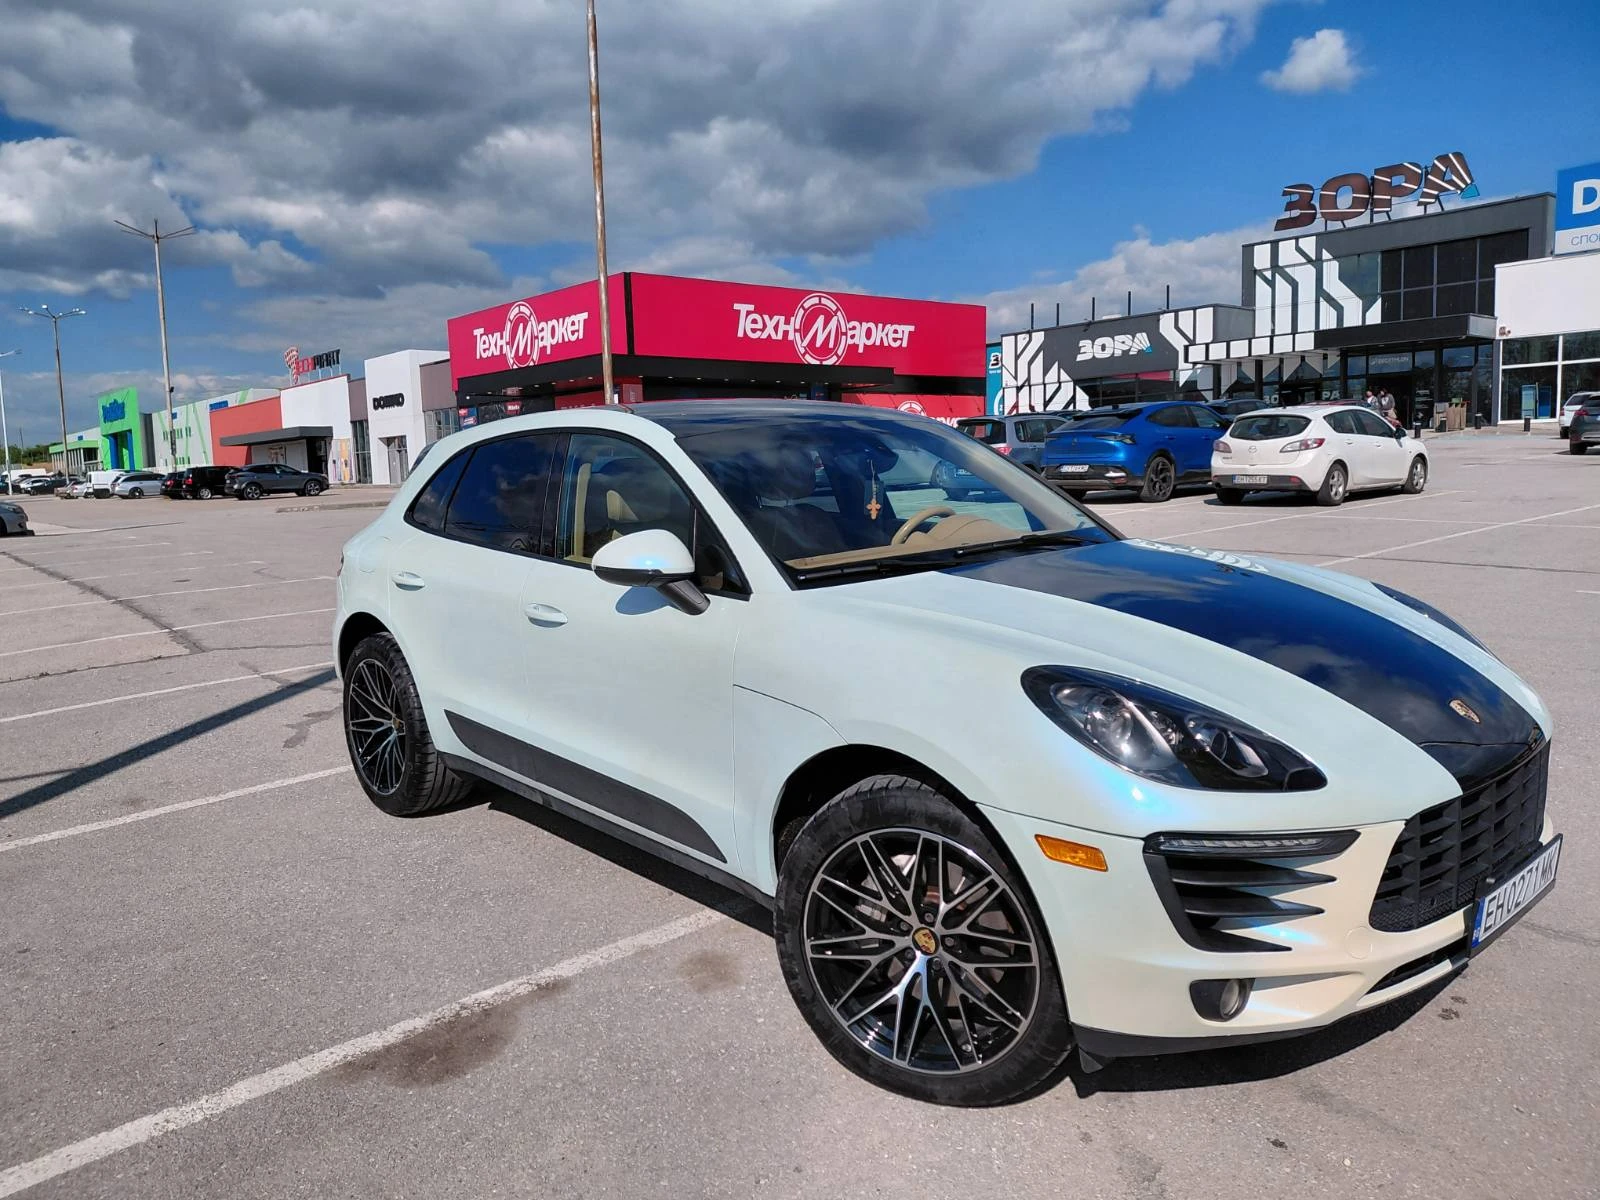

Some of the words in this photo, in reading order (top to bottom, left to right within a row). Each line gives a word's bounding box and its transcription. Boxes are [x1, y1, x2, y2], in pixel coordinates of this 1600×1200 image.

[1274, 152, 1479, 231] ЗОРА
[1571, 232, 1600, 246] СПО
[1076, 332, 1152, 362] ЗОРА
